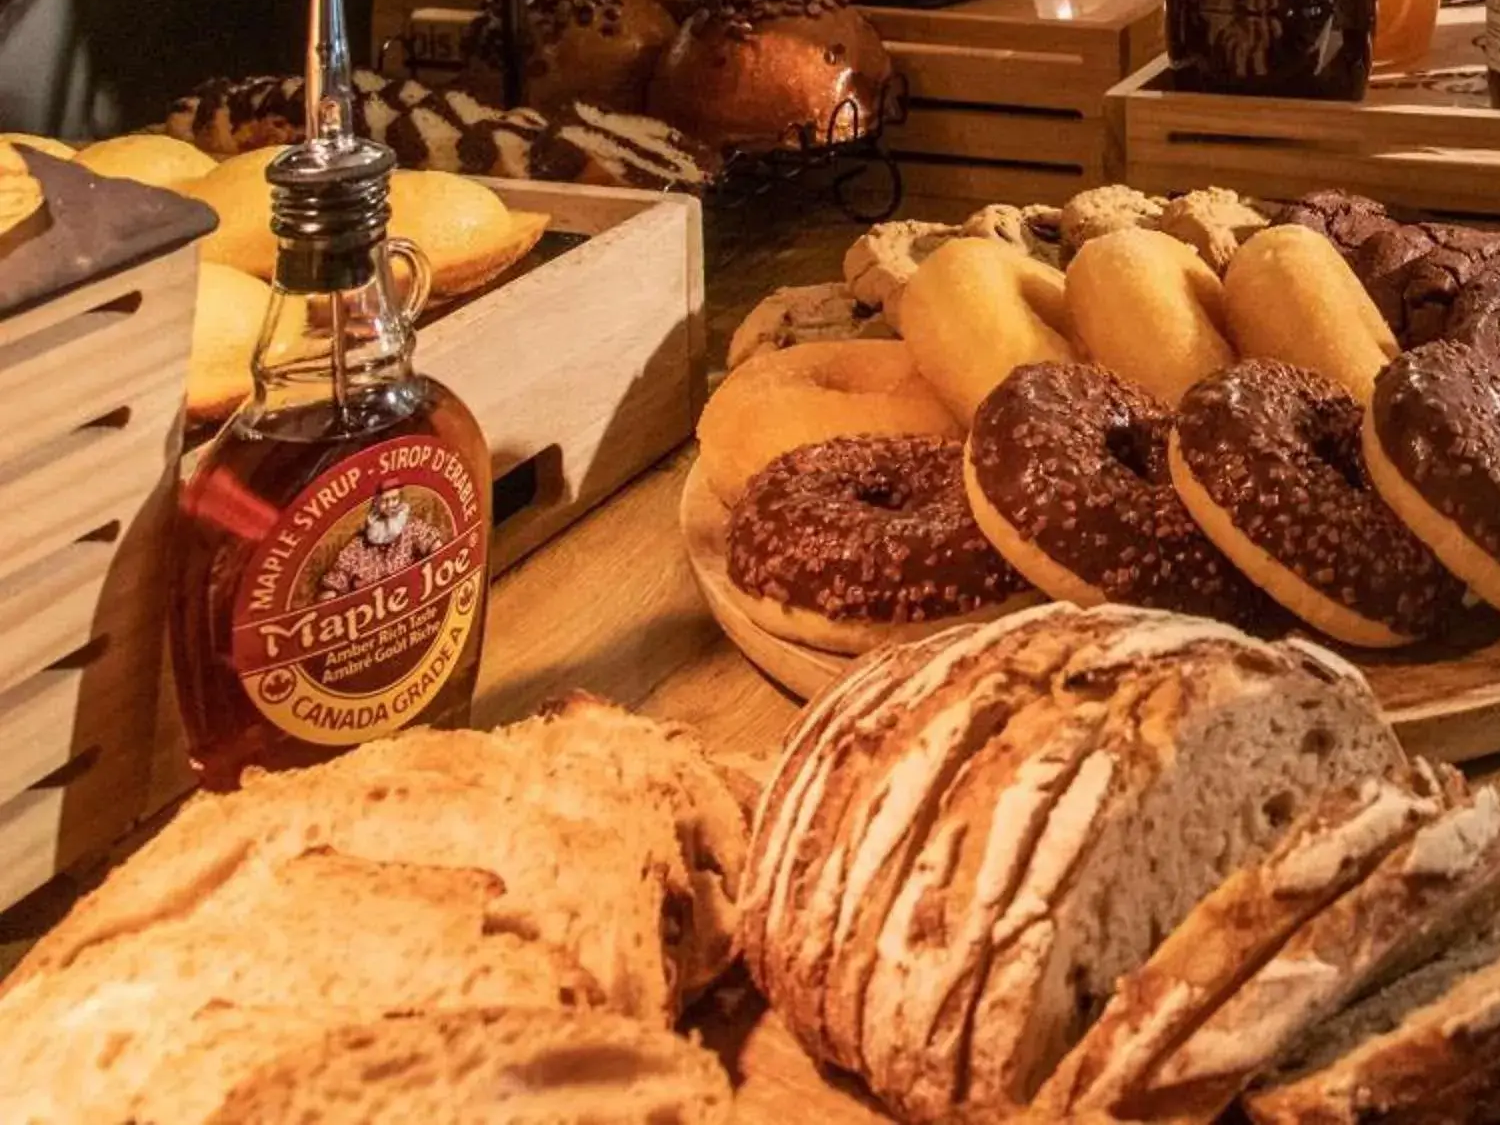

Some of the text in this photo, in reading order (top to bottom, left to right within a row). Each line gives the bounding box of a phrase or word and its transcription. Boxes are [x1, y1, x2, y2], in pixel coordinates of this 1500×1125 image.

[250, 529, 300, 610] MAPLE
[294, 468, 361, 530] SYRUP
[378, 445, 432, 474] SIROP
[432, 447, 477, 522] D'ÉRABLE
[260, 548, 471, 658] Maple Joe
[325, 635, 375, 666] Amber
[378, 623, 407, 644] Rich
[291, 627, 463, 731] CANADA GRADE A
[321, 654, 373, 684] Ambré
